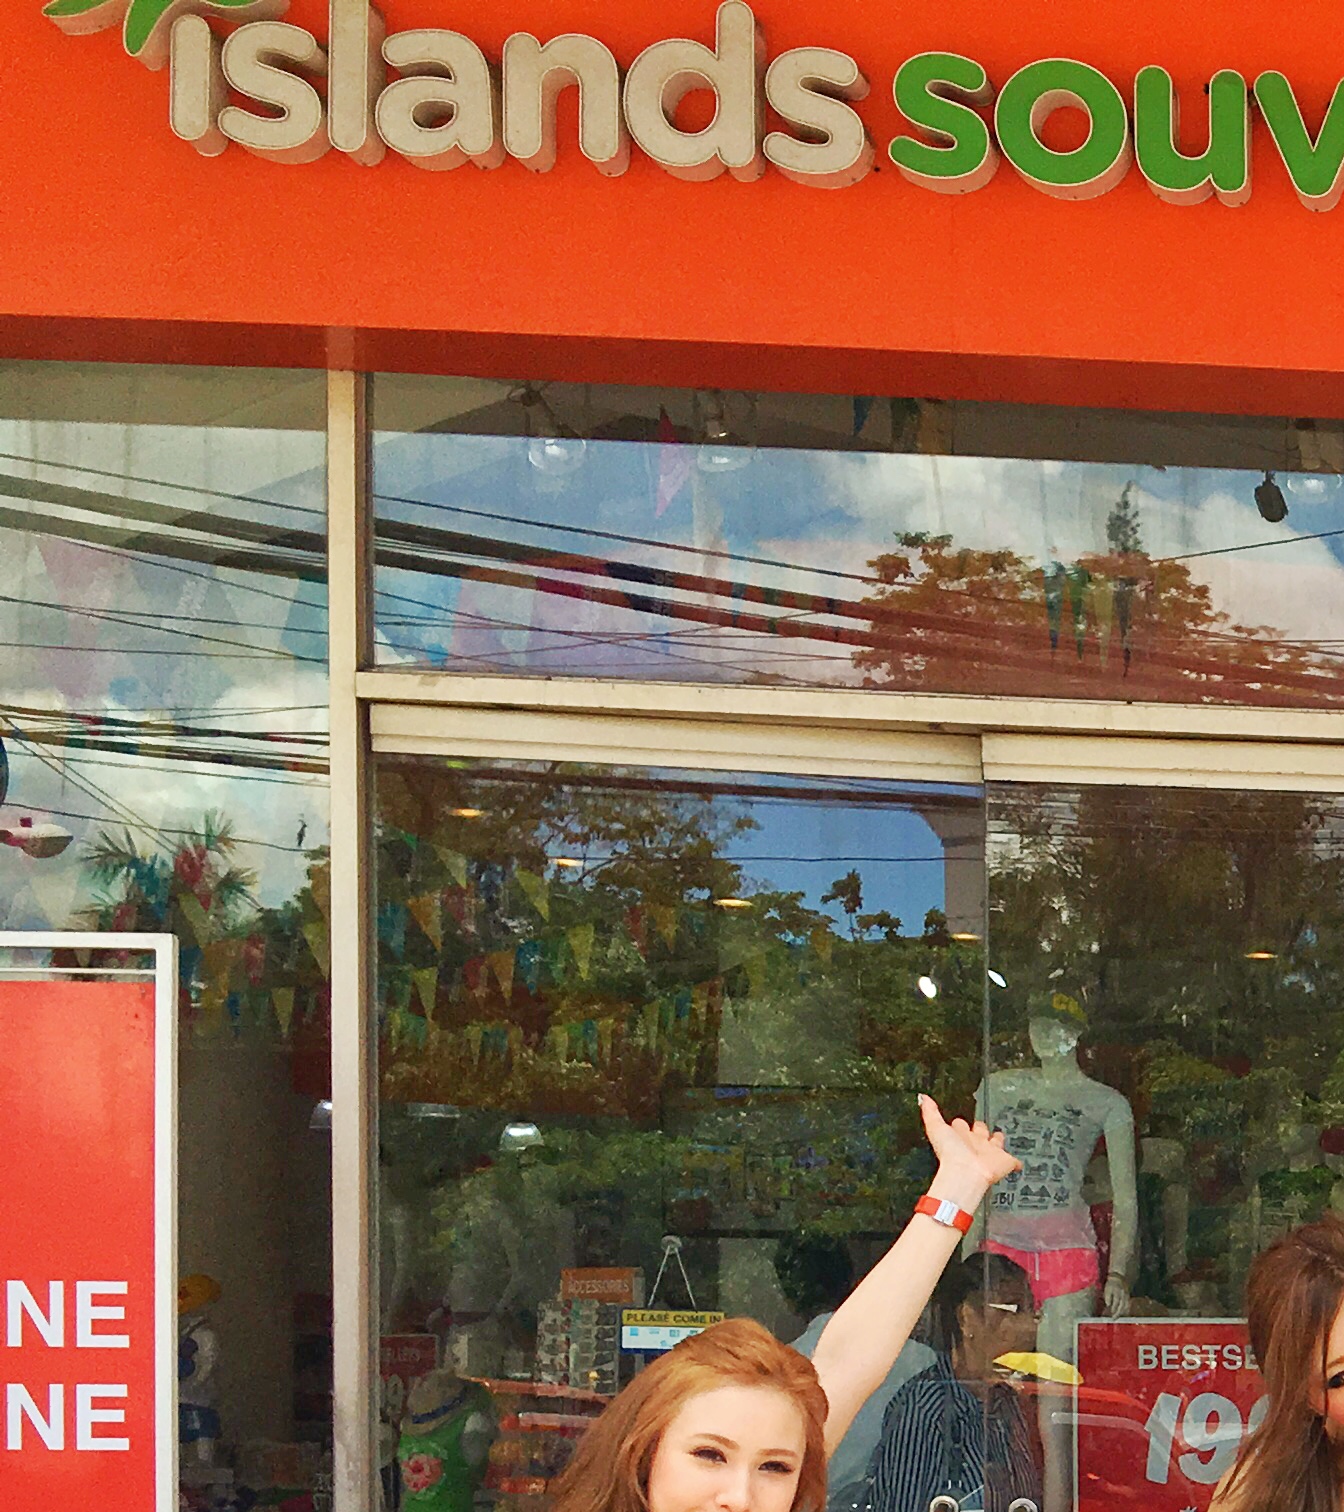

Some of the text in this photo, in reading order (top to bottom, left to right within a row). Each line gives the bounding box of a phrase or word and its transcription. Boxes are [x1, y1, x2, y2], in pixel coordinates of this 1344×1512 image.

[168, 0, 874, 184] islands
[6, 1279, 130, 1349] NE
[626, 1312, 722, 1324] PLEASE COME IN
[6, 1382, 130, 1451] NE
